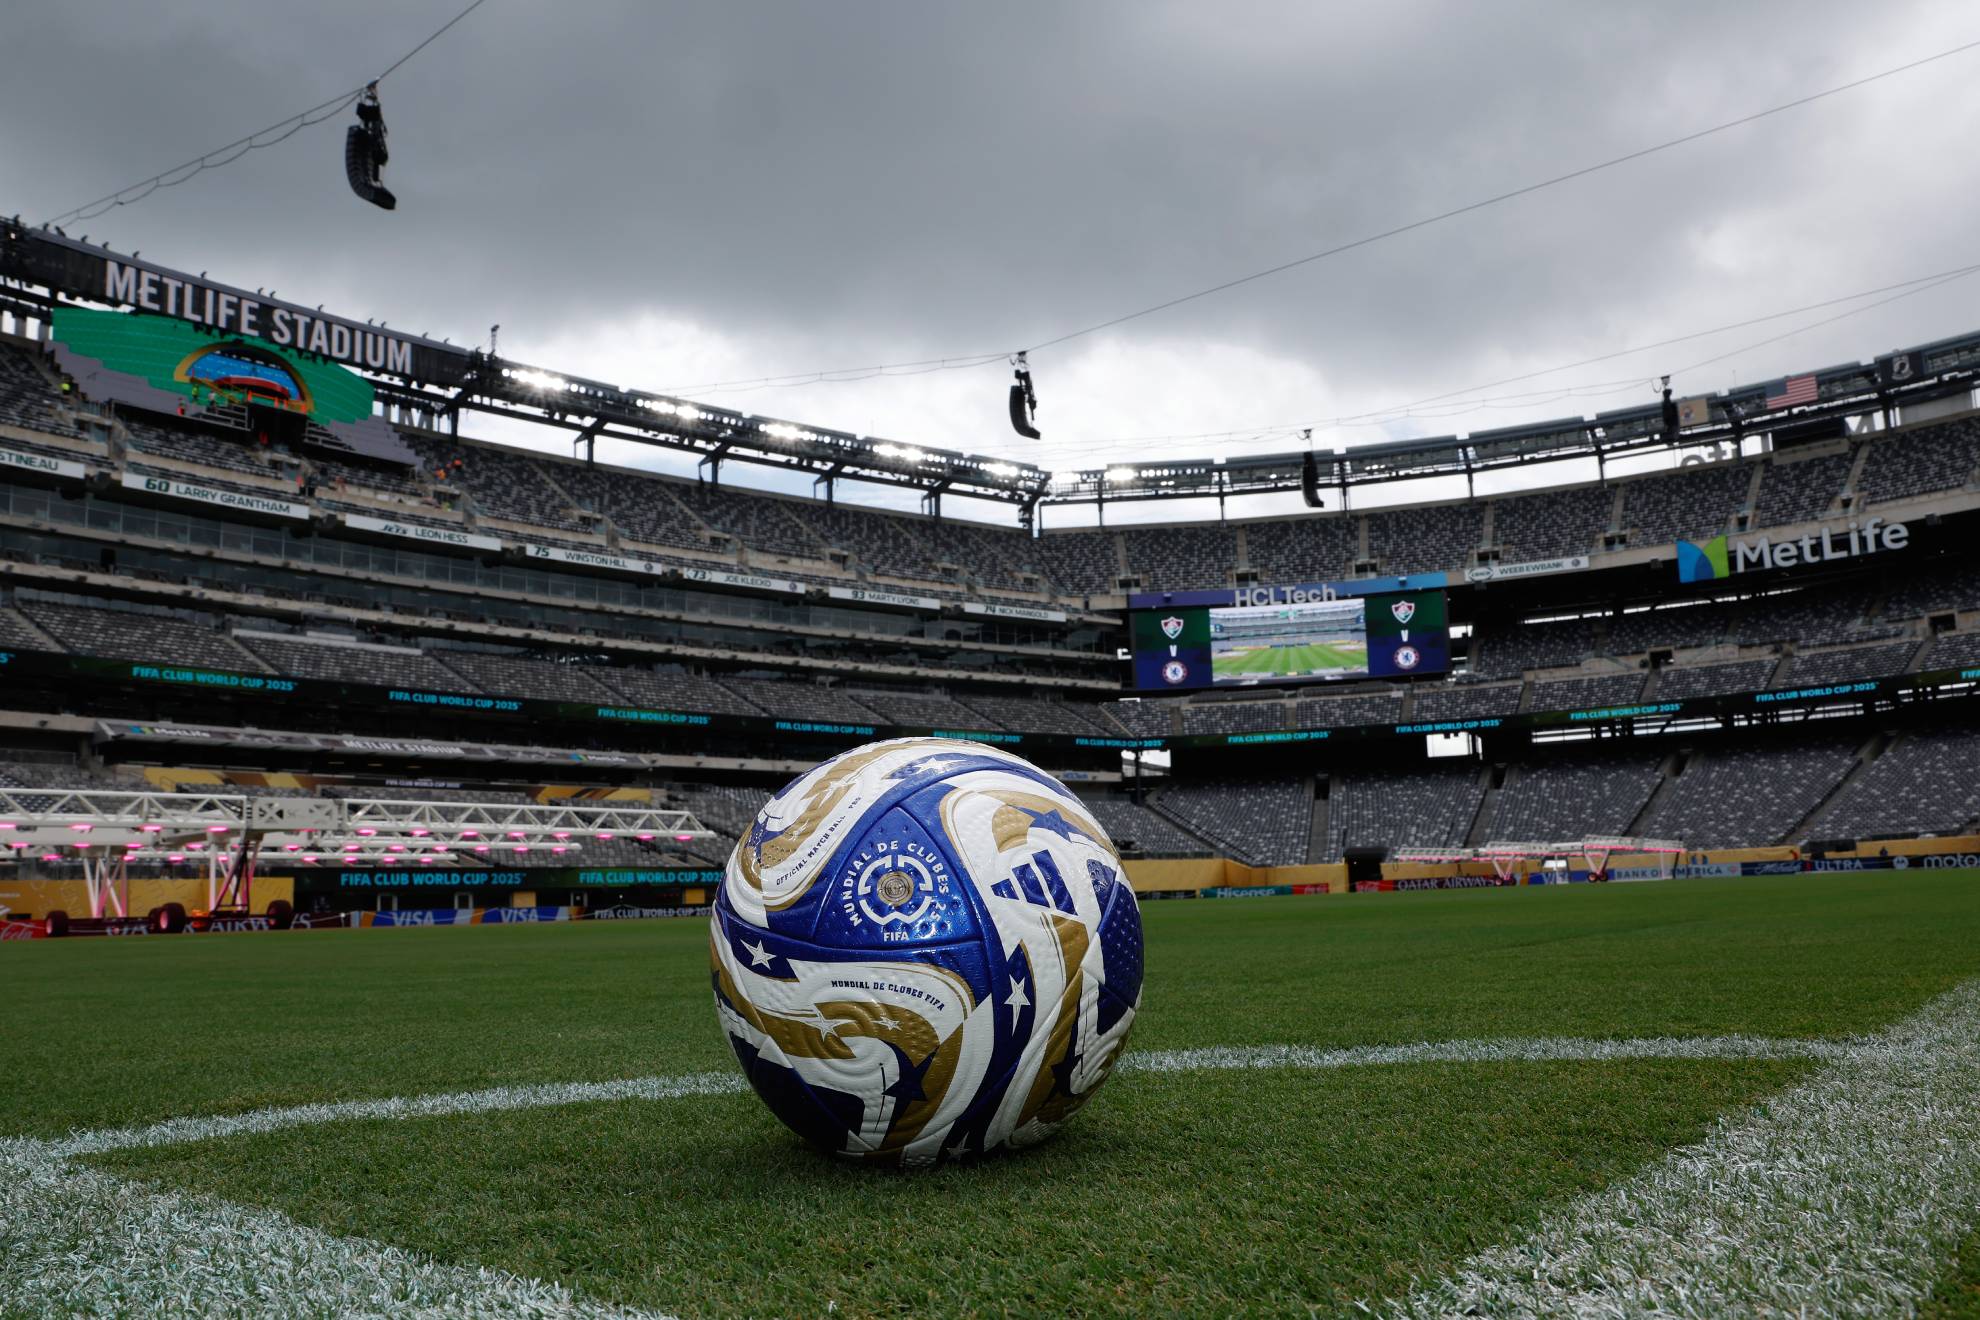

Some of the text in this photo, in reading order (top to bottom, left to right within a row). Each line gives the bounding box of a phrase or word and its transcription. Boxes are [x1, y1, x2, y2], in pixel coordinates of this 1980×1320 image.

[106, 260, 412, 375] METLIFE STADIUM
[145, 478, 290, 514] 60 LARRY GRANTHAM
[415, 527, 441, 541] LEON
[443, 531, 468, 544] HESS
[1735, 517, 1909, 574] MetLife
[534, 546, 627, 568] 75 WINSTON HILL
[693, 569, 706, 580] 73
[723, 574, 740, 584] JOE
[852, 590, 865, 600] 93
[1170, 645, 1177, 657] V
[132, 666, 293, 691] FIFA CLUB WORLD CUP 2025
[389, 690, 518, 711] FIFA CLUB WORLD CUP 2025
[1755, 692, 1775, 702] FIFA
[1776, 690, 1798, 701] CLUB
[1800, 688, 1832, 698] WORLD
[1833, 685, 1851, 695] CUP
[598, 708, 616, 718] FIFA
[617, 710, 639, 720] CLUB
[639, 711, 670, 723] WORLD
[670, 713, 687, 724] CUP
[1570, 712, 1587, 721] FIFA
[1588, 710, 1609, 719] CLUB
[1610, 708, 1639, 717] WORLD
[1641, 705, 1658, 715] CUP
[776, 721, 792, 731] FIFA
[792, 722, 811, 732] CLUB
[812, 723, 839, 734] WORLD
[840, 725, 854, 735] CUP
[1396, 725, 1414, 734] FIFA
[1414, 724, 1436, 733] CLUB
[1436, 722, 1462, 731] WORLD
[1463, 720, 1479, 730] CUP
[1228, 736, 1244, 744] FIFA
[1244, 735, 1264, 743] CLUB
[1265, 733, 1293, 742] WORLD
[1293, 732, 1309, 741] CUP
[776, 859, 808, 886] OFFICIAL
[807, 832, 830, 858] MATCH
[828, 815, 846, 833] BALL
[1815, 859, 1864, 871] ULTRA
[1923, 854, 1980, 869] moto
[340, 872, 522, 886] FIFA CLUB WORLD CUP 2025
[579, 873, 603, 884] FIFA
[606, 873, 635, 884] CLUB
[637, 873, 675, 883] WORLD
[677, 872, 698, 882] CUP
[1616, 869, 1648, 879] BANK
[1671, 865, 1723, 878] MERICA
[842, 840, 950, 927] MUNDIAL DE CLUBES 25
[1398, 876, 1496, 891] QATAR AIRWAYS
[1217, 887, 1275, 899] Hisense
[392, 910, 435, 926] VISA
[500, 908, 539, 922] VISA
[594, 907, 712, 919] FIFA CLUB WORLD CUP 202
[883, 931, 910, 942] FIFA
[831, 980, 945, 1012] MUNDIAL DE CLUBES FIFA
